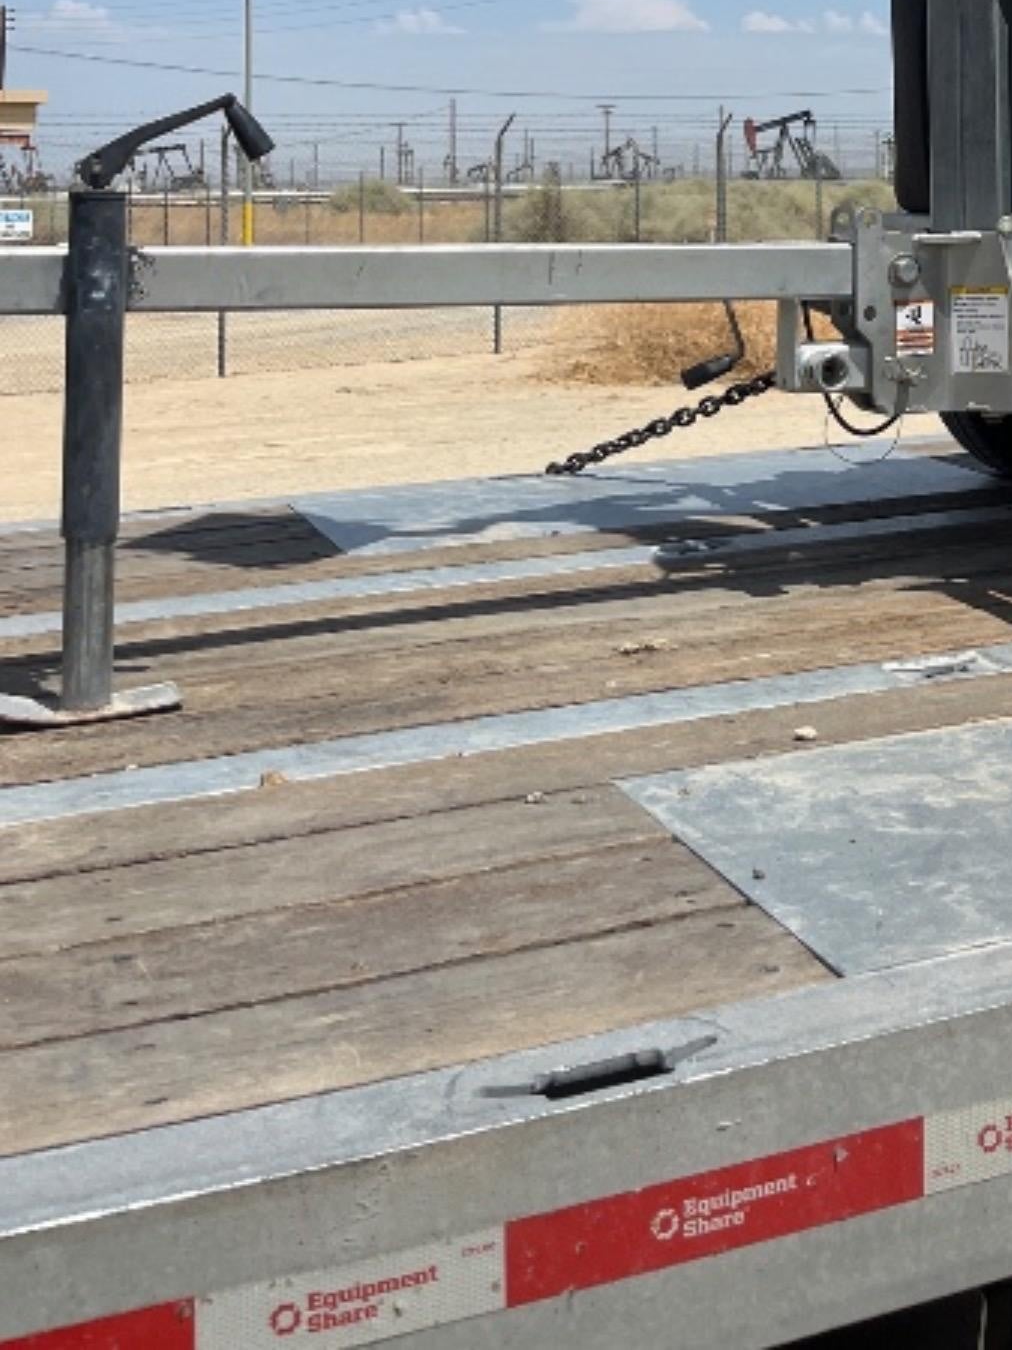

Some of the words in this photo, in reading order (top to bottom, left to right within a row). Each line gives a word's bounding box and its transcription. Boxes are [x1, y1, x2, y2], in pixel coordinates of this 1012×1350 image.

[683, 1173, 797, 1217] Equipment
[683, 1211, 745, 1237] Share
[307, 1265, 438, 1310] Equipment
[307, 1304, 378, 1332] Share
